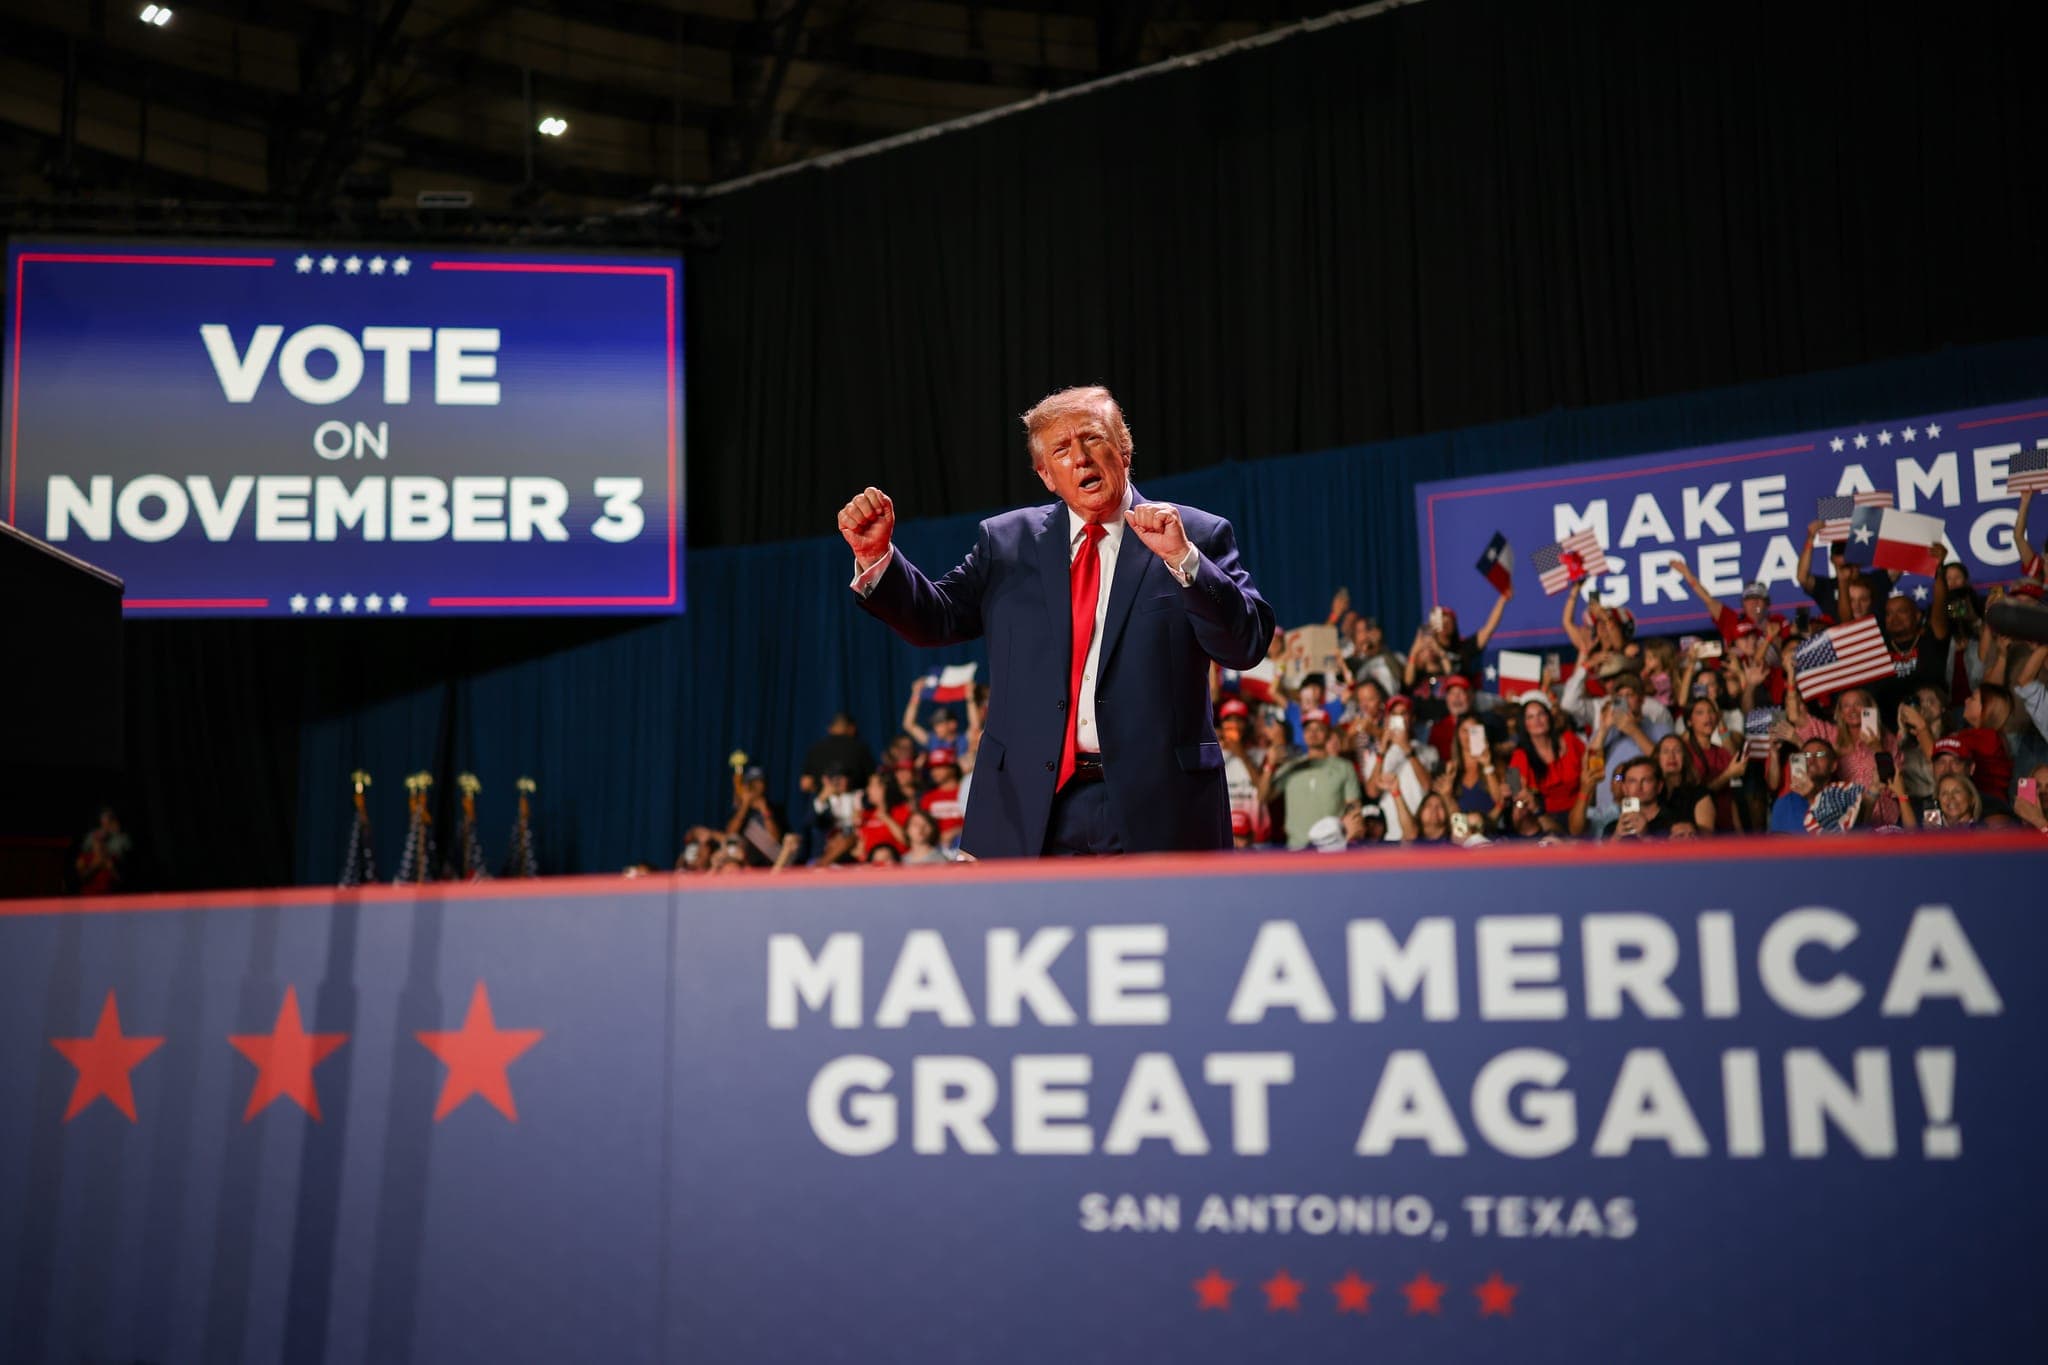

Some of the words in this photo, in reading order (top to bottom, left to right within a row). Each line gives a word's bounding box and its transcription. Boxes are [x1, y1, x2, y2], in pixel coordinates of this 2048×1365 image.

[201, 324, 501, 406] VOTE
[313, 420, 389, 460] ON
[46, 473, 570, 543] NOVEMBER
[591, 476, 645, 543] 3
[1553, 474, 1790, 551] MAKE
[1835, 438, 2048, 514] AME
[766, 924, 1171, 1028] MAKE
[1227, 907, 2002, 1025] AMERICA
[805, 1051, 1295, 1158] GREAT
[1355, 1048, 1961, 1159] AGAIN!
[1079, 1192, 1181, 1234] SAN
[1195, 1193, 1449, 1242] ANTONIO,
[1462, 1195, 1639, 1239] TEXAS
